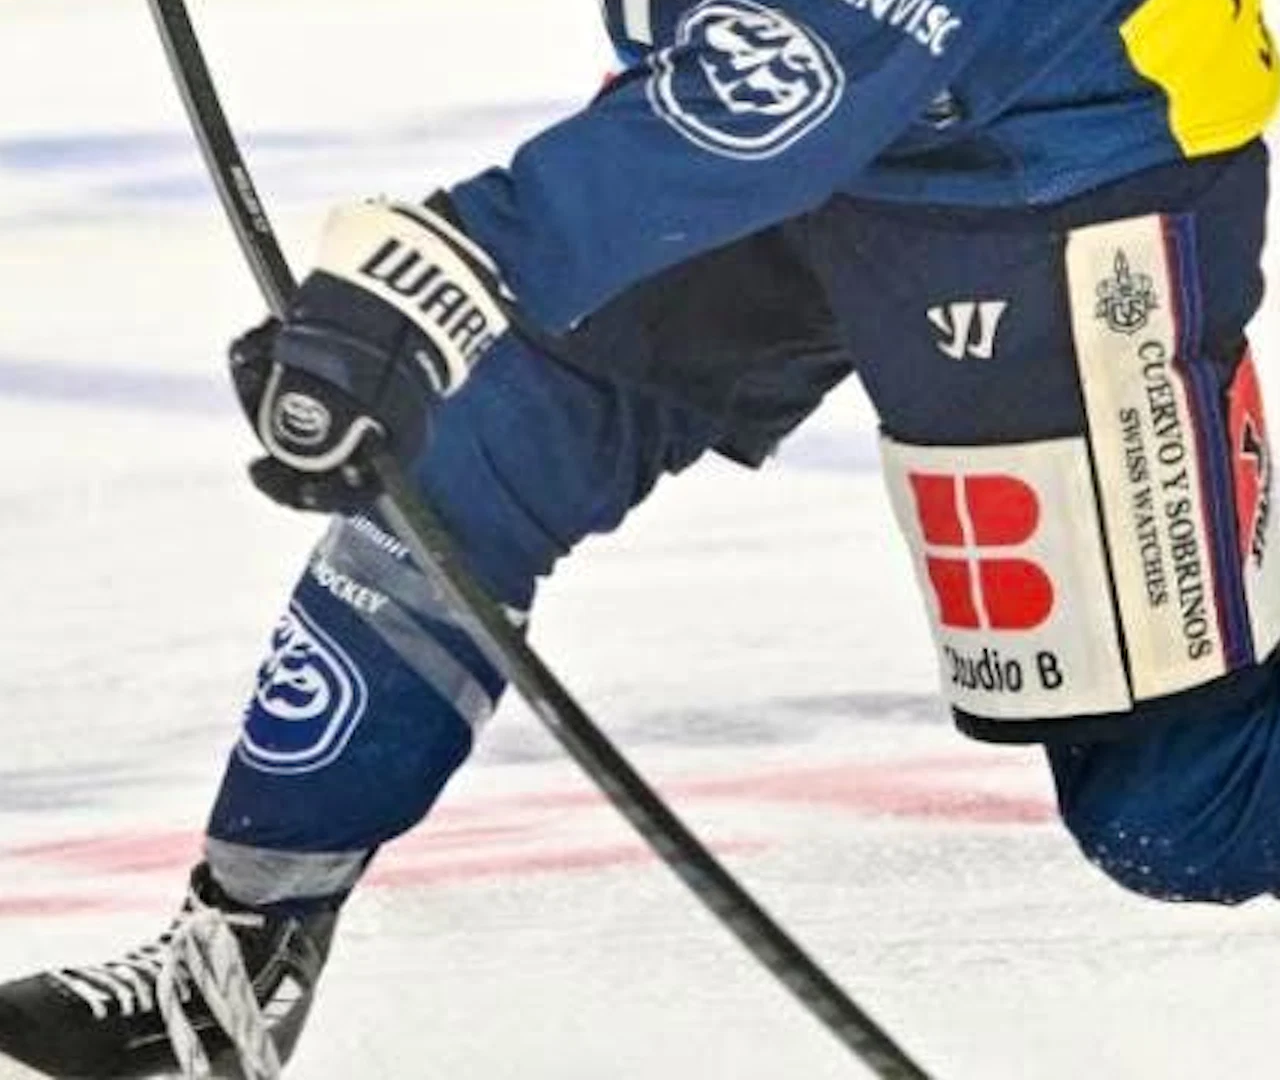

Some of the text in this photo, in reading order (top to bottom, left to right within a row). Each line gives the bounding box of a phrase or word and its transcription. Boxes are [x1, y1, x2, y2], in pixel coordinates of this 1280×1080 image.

[1119, 407, 1170, 609] SWISS WATCHES
[1137, 339, 1213, 662] CUERVO Y SOBRINOS
[1035, 650, 1064, 690] B
